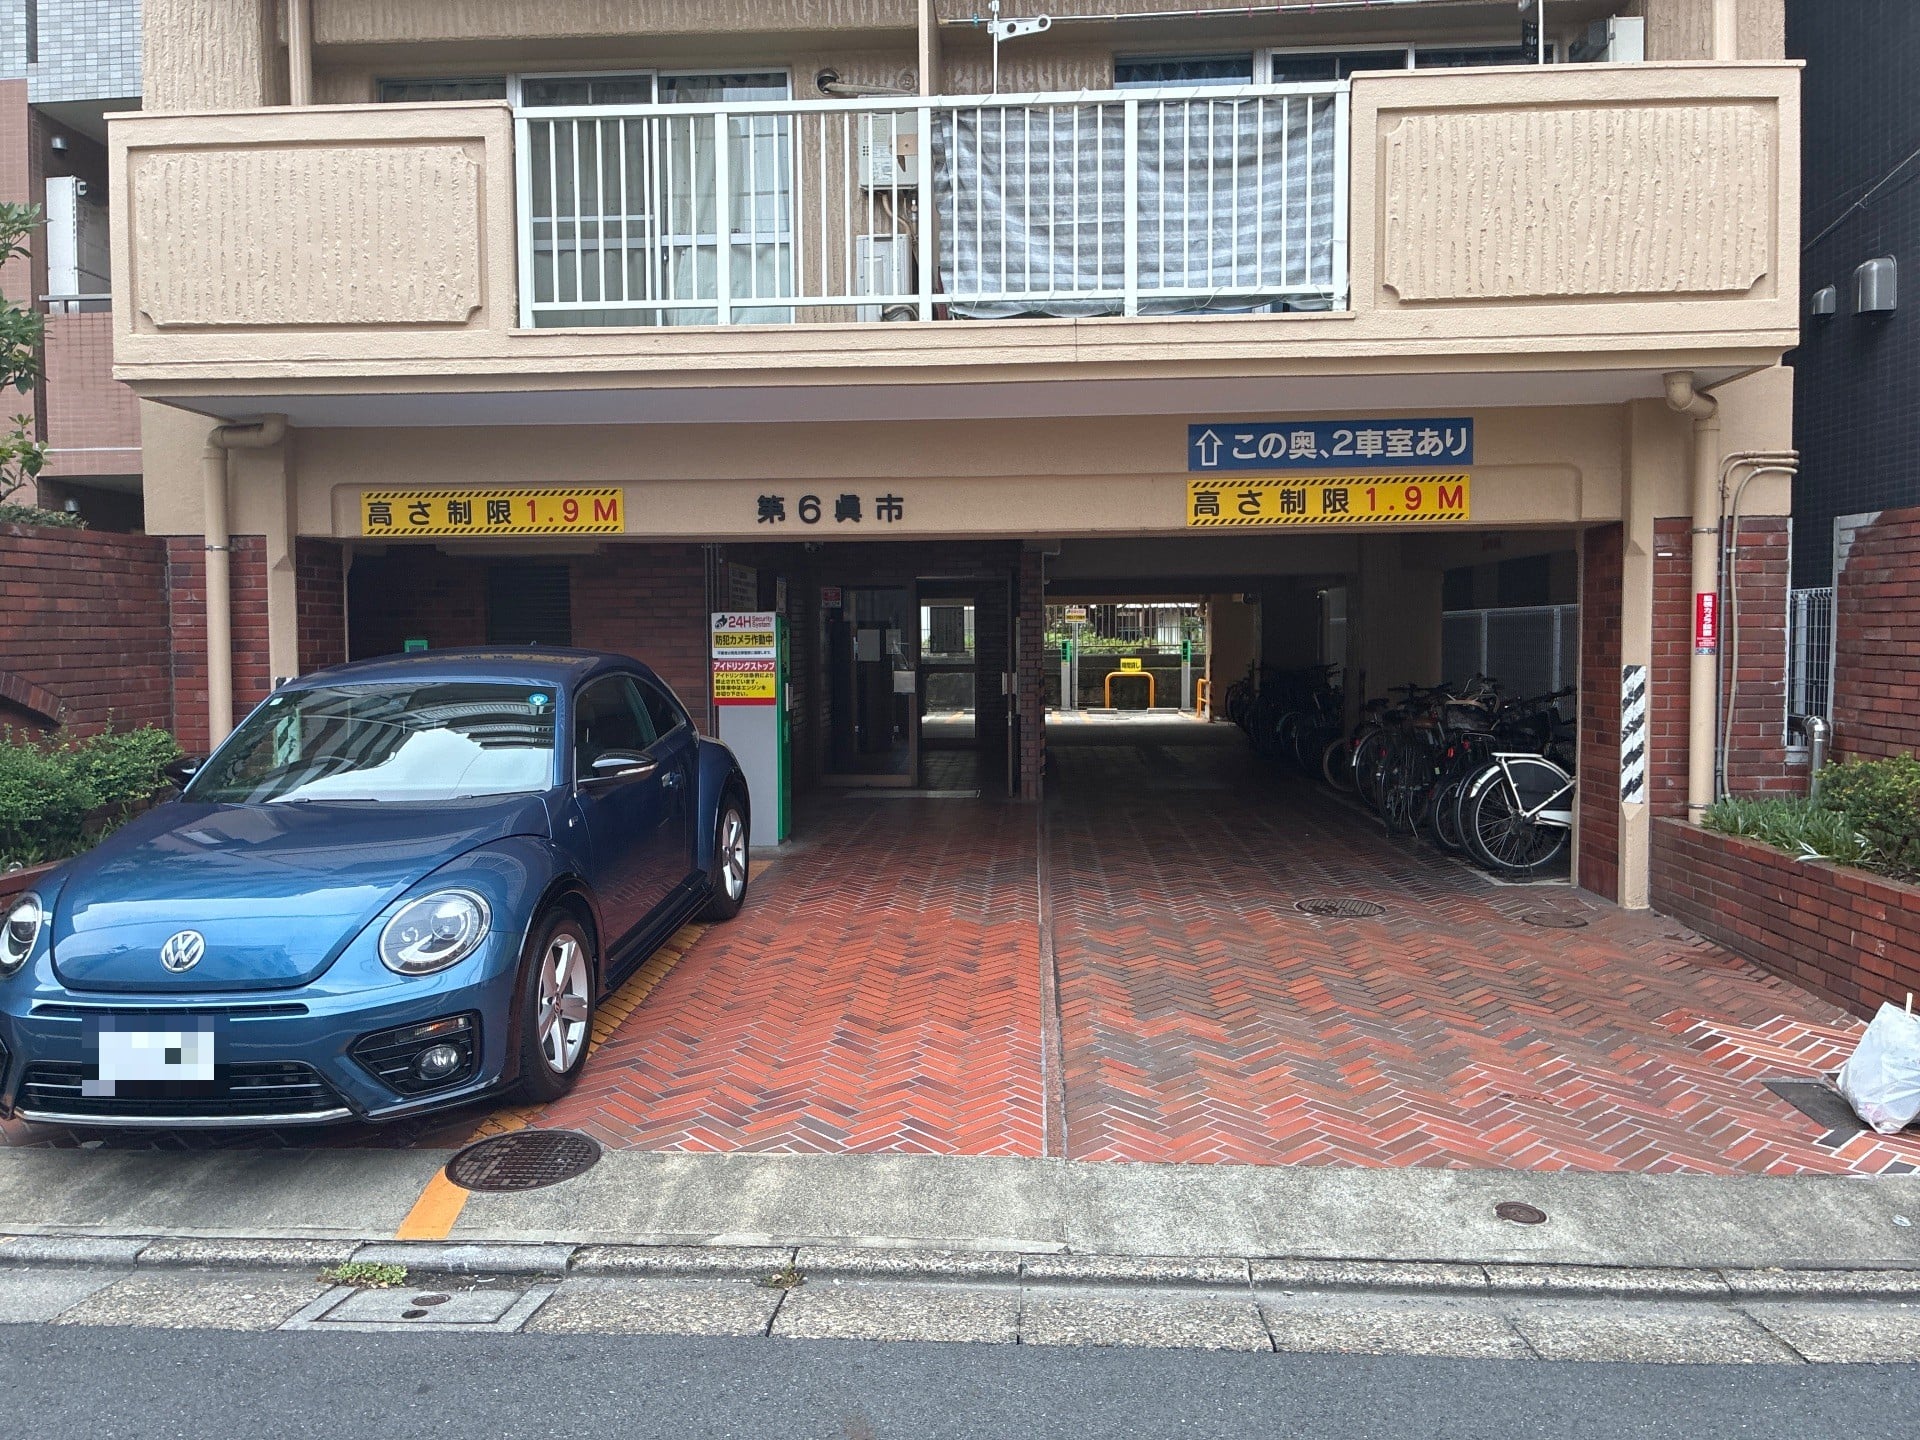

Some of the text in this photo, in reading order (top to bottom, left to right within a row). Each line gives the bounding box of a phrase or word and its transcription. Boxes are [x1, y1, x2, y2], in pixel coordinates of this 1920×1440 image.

[1232, 427, 1467, 460] この奥、2車室あり
[1193, 484, 1463, 518] 高さ制限1.9M
[368, 498, 619, 526] 高さ制限1.9M
[728, 615, 751, 628] 24H
[715, 634, 773, 646] 防犯カメラ作動中
[713, 661, 775, 671] アイドリングストップ
